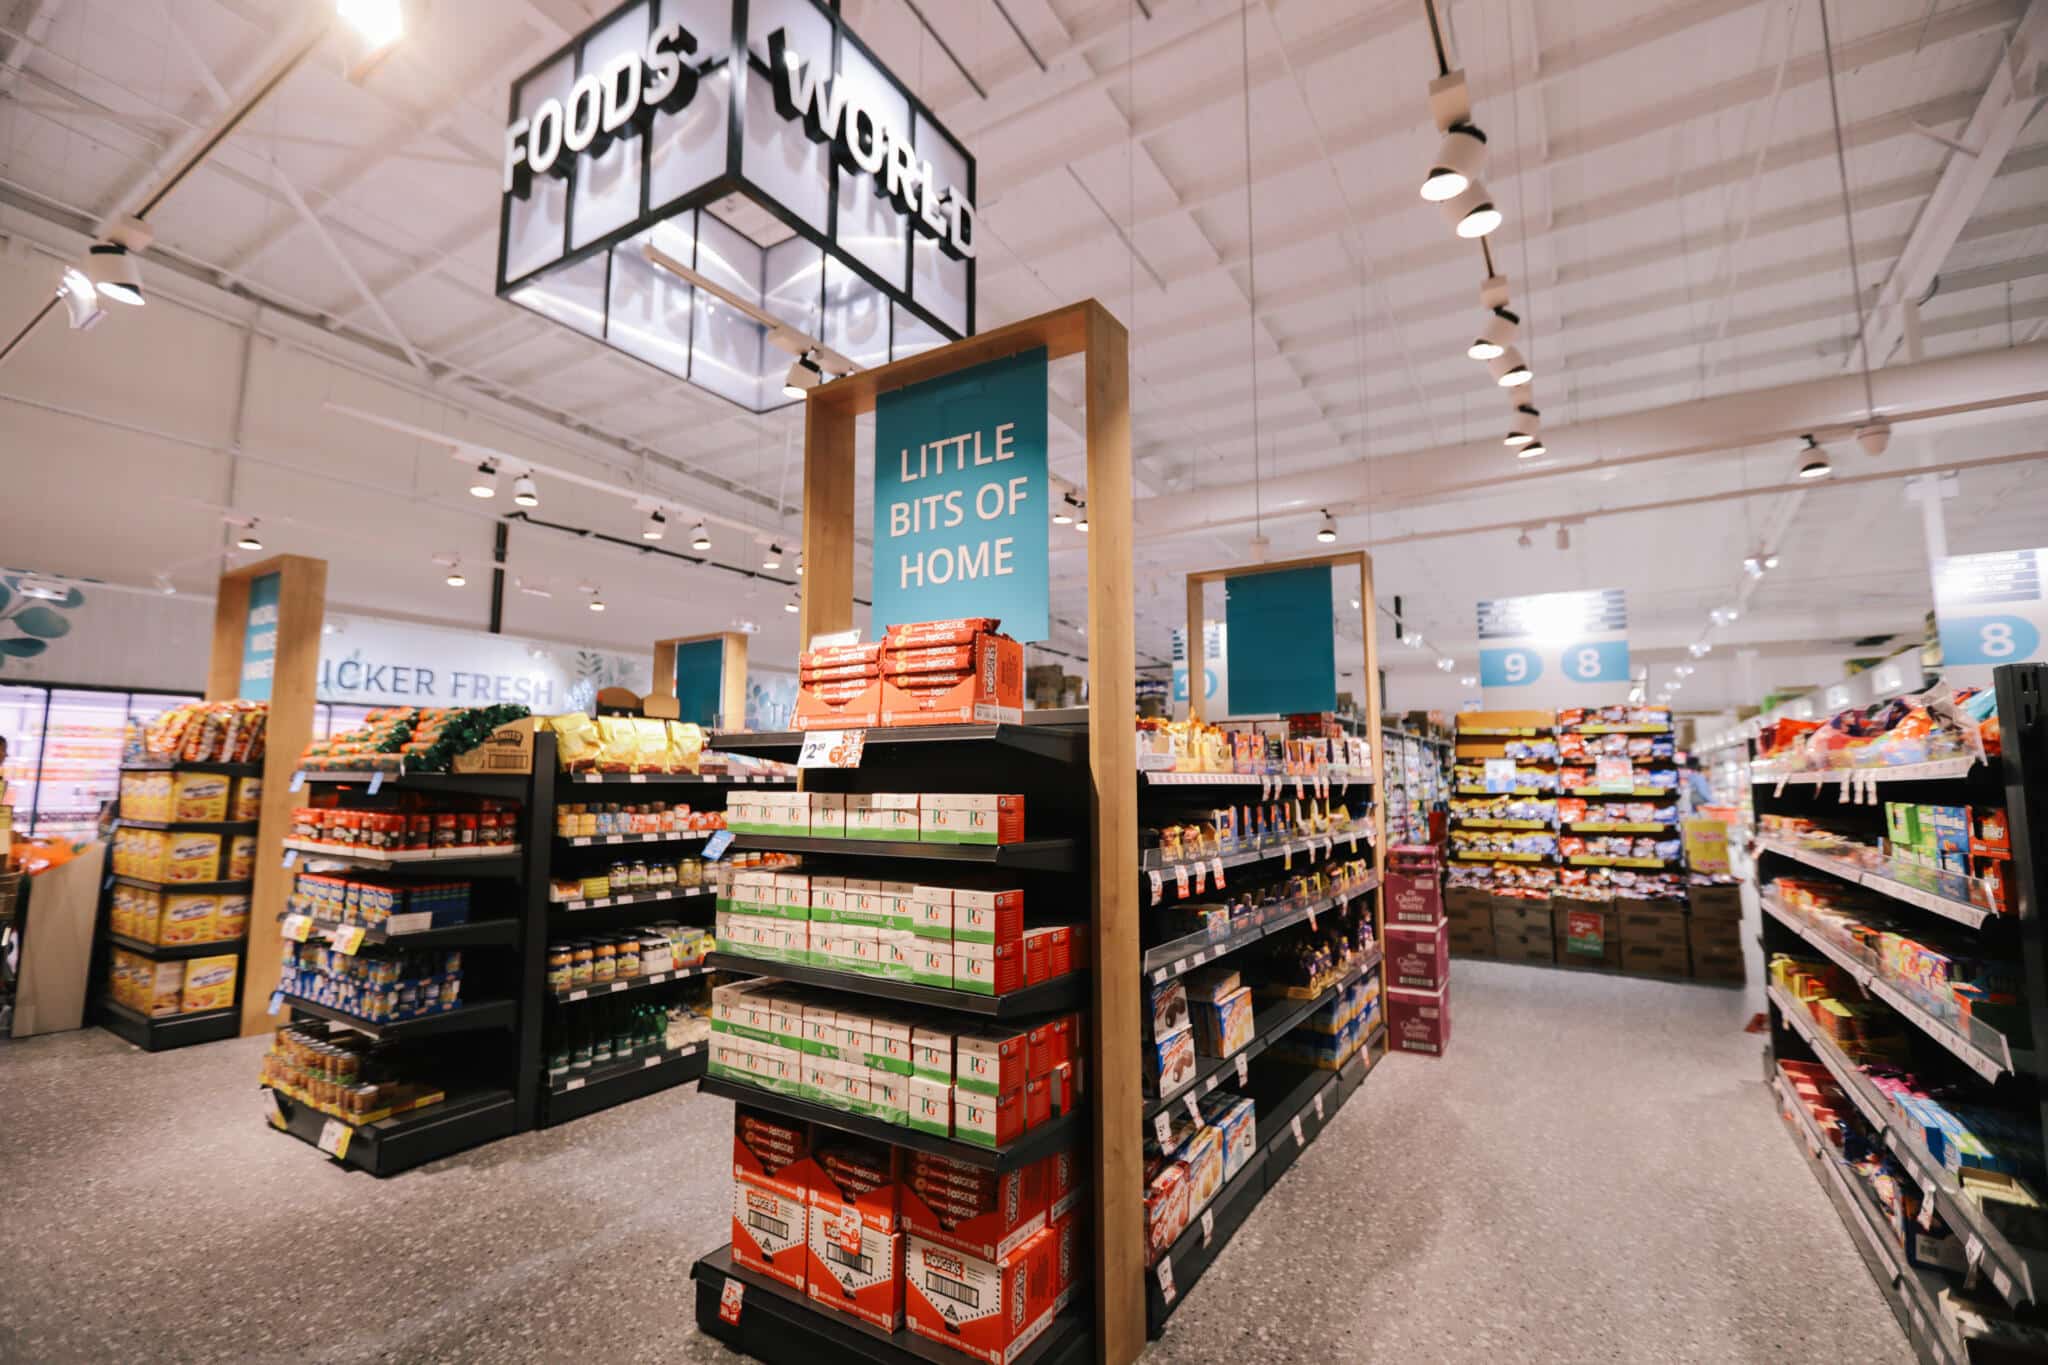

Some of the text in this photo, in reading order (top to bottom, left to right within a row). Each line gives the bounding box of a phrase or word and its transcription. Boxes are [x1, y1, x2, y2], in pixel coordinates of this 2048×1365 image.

[503, 23, 690, 195] FOODS
[778, 28, 976, 258] WORLD
[901, 422, 1014, 483] LITTLE
[890, 476, 1028, 537] BITS OF
[901, 537, 1013, 589] HOME
[1980, 623, 2015, 657] 8
[1504, 652, 1528, 682] 9
[1577, 648, 1601, 678] 8
[451, 671, 553, 705] FRESH
[823, 807, 834, 822] PG
[858, 808, 870, 823] PG
[893, 809, 906, 824] PG
[933, 809, 947, 825] PG
[969, 810, 984, 826] PG
[823, 892, 834, 905] PG
[858, 895, 870, 909] PG
[893, 896, 907, 913] PG
[926, 904, 941, 921] PG
[967, 908, 983, 925] PG
[854, 941, 866, 956] PG
[890, 944, 904, 961] PG
[926, 952, 941, 969] PG
[967, 959, 982, 975] PG
[814, 1023, 825, 1039] PG
[848, 1030, 860, 1046] PG
[884, 1037, 897, 1054] PG
[924, 1046, 939, 1065] PG
[970, 1056, 986, 1074] PG
[812, 1070, 823, 1085] PG
[846, 1077, 858, 1095] PG
[884, 1086, 897, 1103] PG
[921, 1097, 936, 1116] PG
[968, 1105, 983, 1124] PG
[926, 1252, 961, 1275] DODGERS
